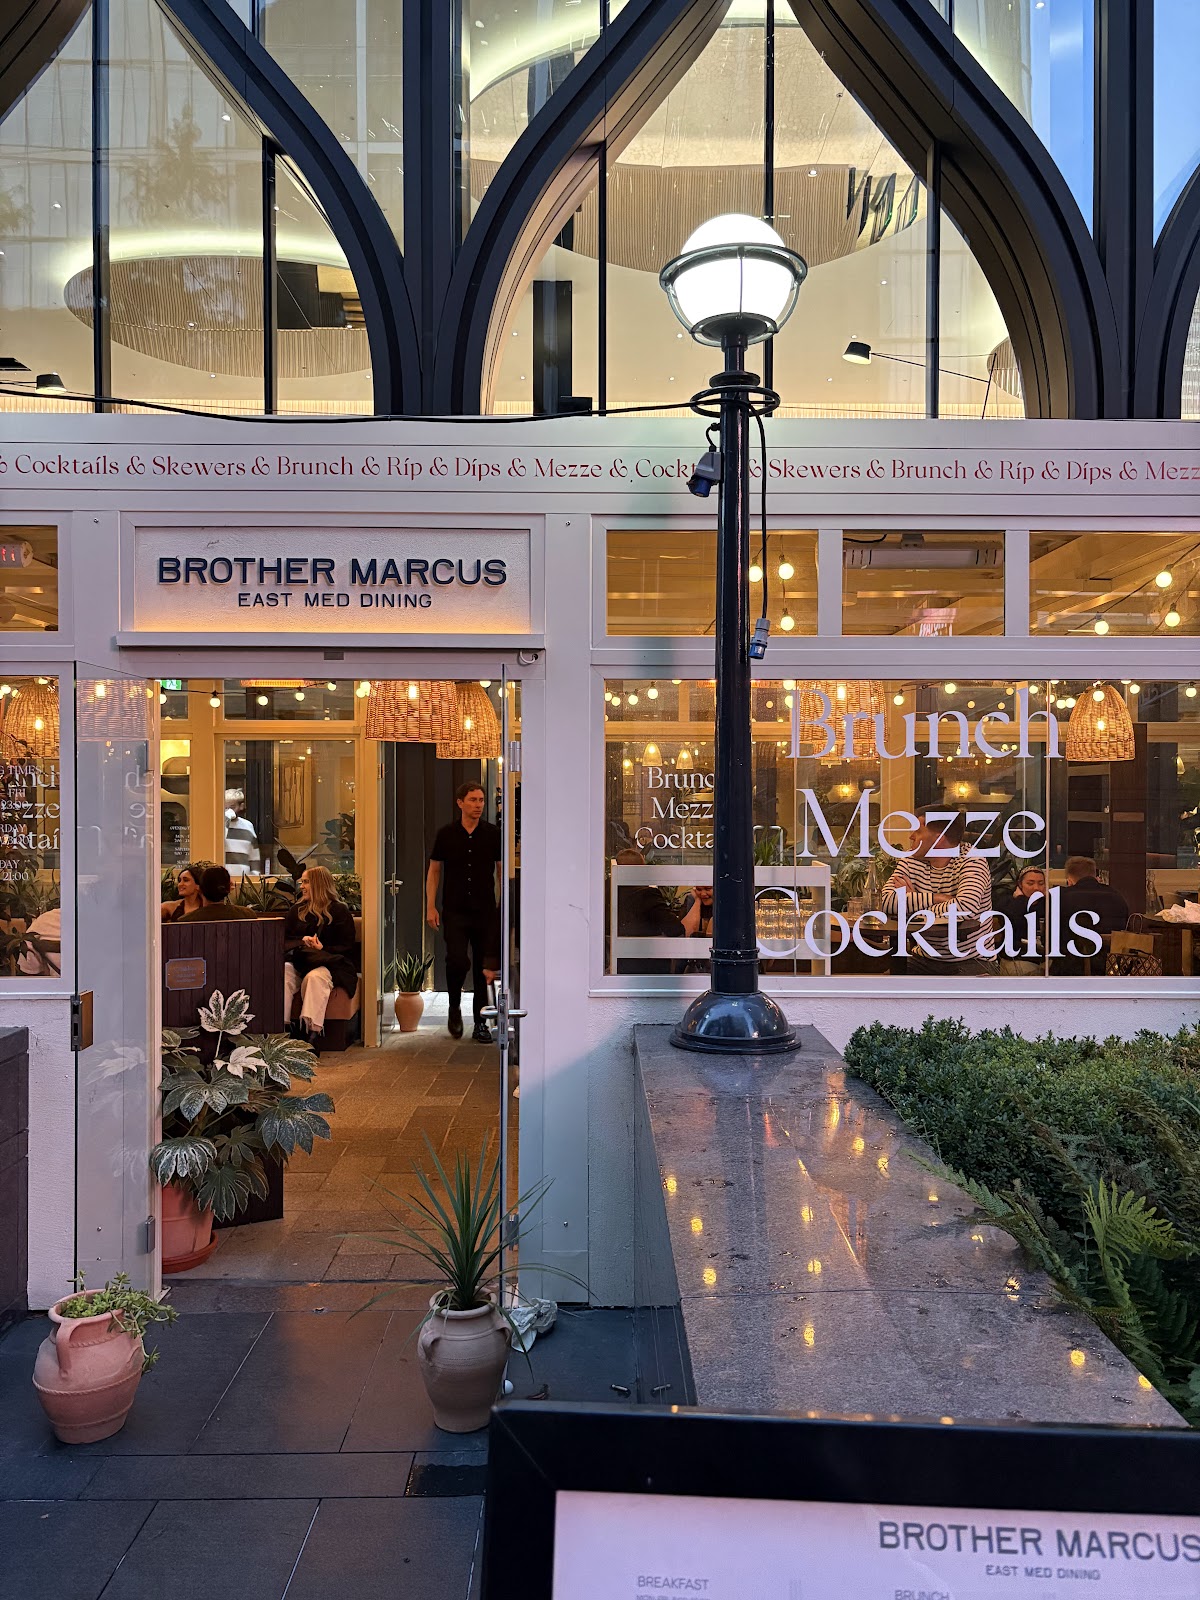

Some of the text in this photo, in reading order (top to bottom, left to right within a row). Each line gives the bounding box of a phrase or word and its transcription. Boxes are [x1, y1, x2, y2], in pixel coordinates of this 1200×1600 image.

[126, 455, 146, 476] &
[152, 455, 246, 476] Skewers
[251, 455, 271, 476] &
[277, 455, 354, 476] Brunch
[361, 456, 381, 476] &
[429, 456, 449, 477] &
[507, 457, 527, 477] &
[534, 457, 602, 478] Mezze
[609, 458, 628, 478] &
[635, 458, 696, 478] Cockt
[769, 458, 861, 480] Skewers
[866, 459, 885, 480] &
[892, 459, 967, 480] Brunch
[974, 459, 993, 480] &
[1041, 460, 1060, 481] &
[1119, 460, 1138, 481] &
[1145, 461, 1200, 480] Mezz
[157, 557, 508, 586] BROTHER MARCUS
[238, 592, 433, 608] EAST MED DINING
[785, 687, 1065, 760] Brunch
[647, 766, 715, 790] Brunc
[651, 796, 714, 819] Mezz
[0, 824, 27, 833] RDAY
[796, 788, 1047, 859] Mezze
[635, 826, 714, 850] Cockta
[0, 860, 20, 869] DAY
[878, 1520, 1200, 1562] BROTHER MARCUS
[637, 1576, 709, 1591] BREAKFAST
[985, 1564, 1101, 1581] EAST MED DINING
